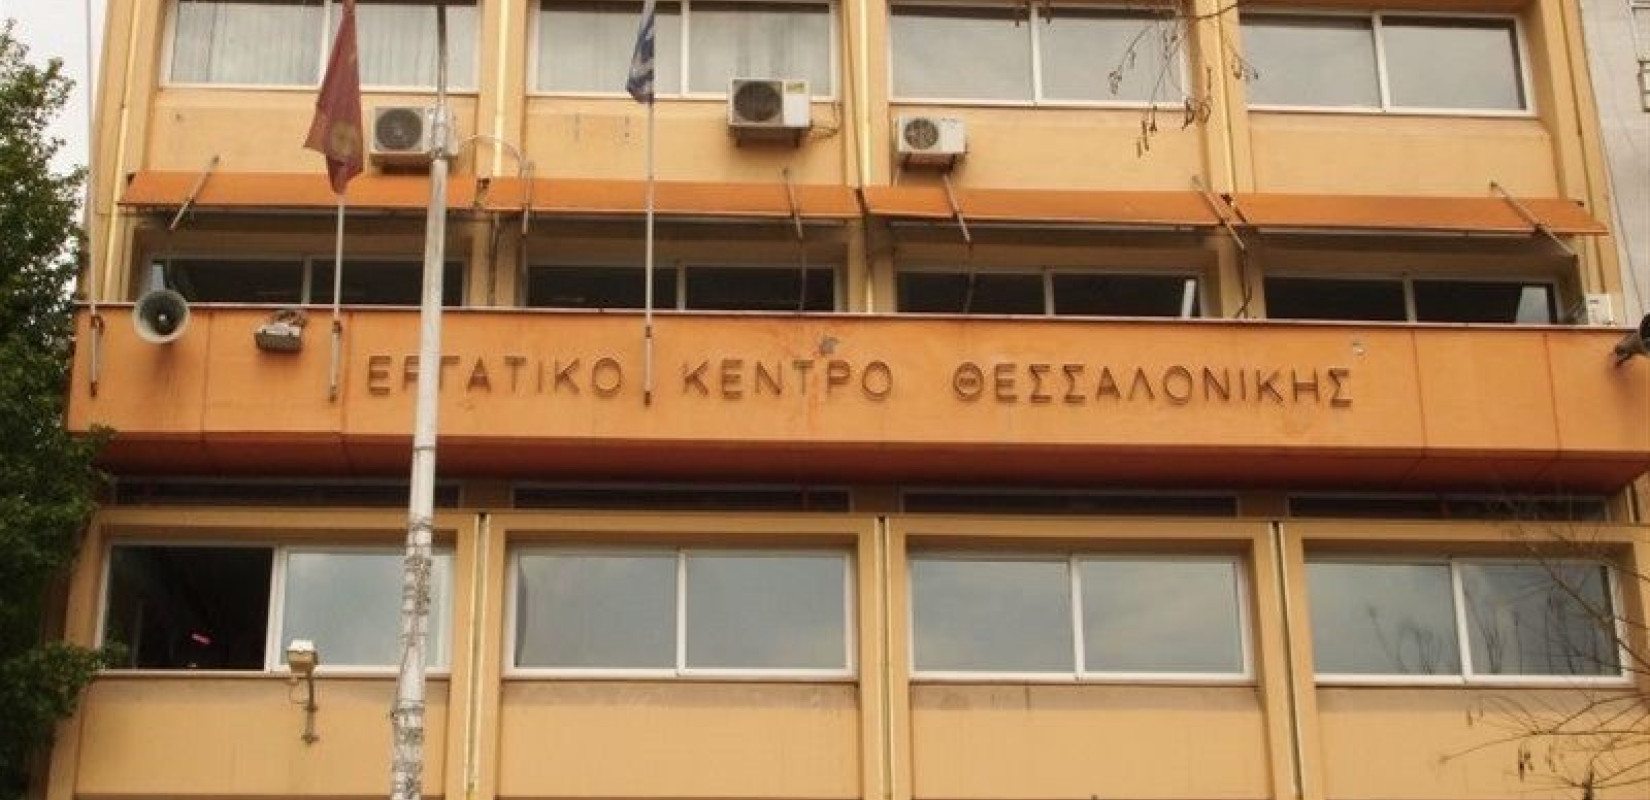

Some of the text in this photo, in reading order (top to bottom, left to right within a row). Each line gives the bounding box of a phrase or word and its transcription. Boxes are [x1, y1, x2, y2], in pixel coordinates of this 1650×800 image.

[367, 355, 1353, 408] ΕΡΓΑΤΙΚΟ ΚΕΝΤΡΟ ΘΕΣΣΑΛΟΝΙΚΗΣ
